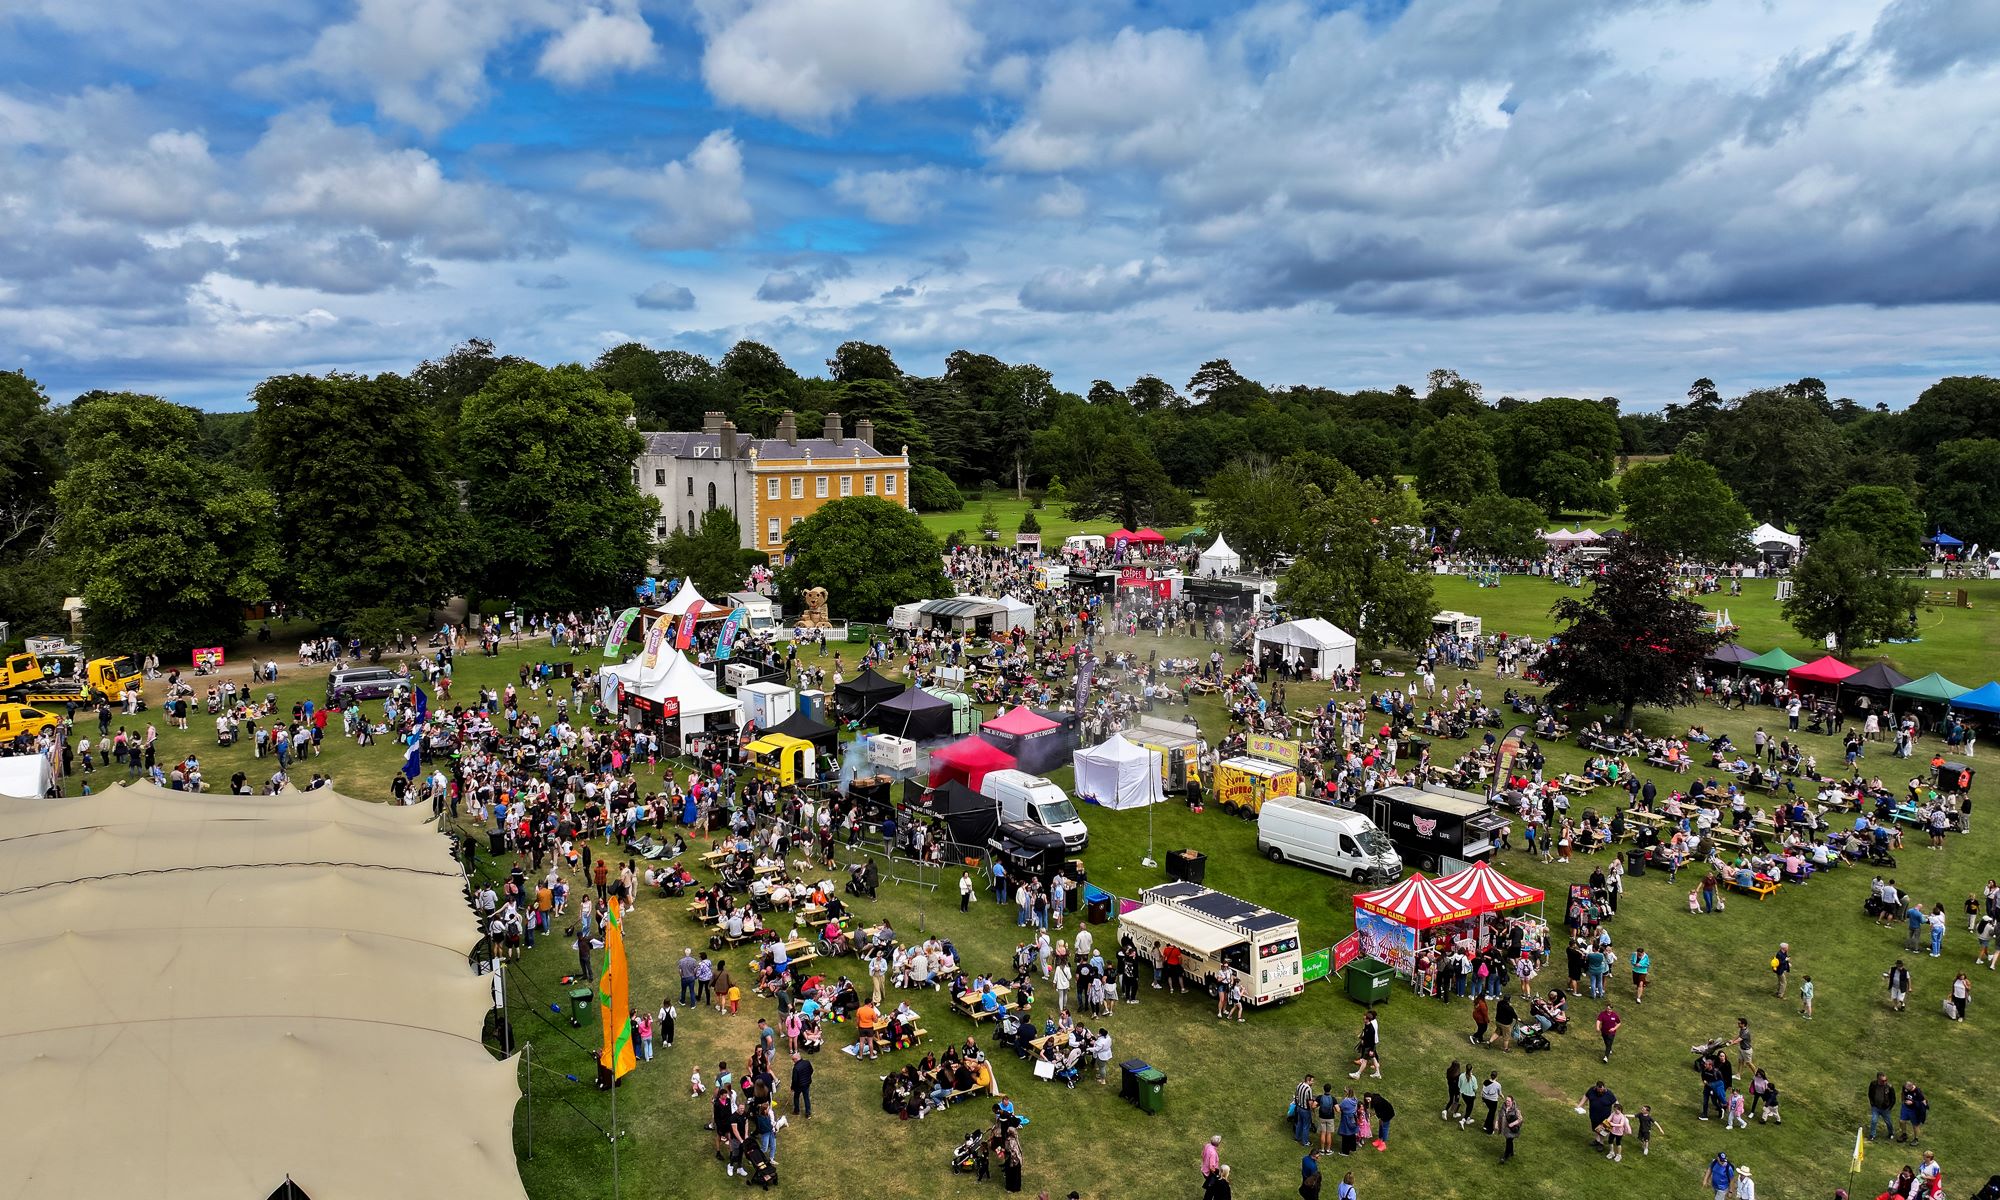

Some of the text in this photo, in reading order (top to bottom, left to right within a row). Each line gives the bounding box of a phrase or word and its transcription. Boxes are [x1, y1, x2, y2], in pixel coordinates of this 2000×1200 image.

[1439, 832, 1451, 840] LIFE
[1494, 895, 1534, 910] FUN AND GAMES
[1364, 902, 1407, 923] FUN AND GAMES
[1430, 909, 1472, 925] FUN AND GAMES
